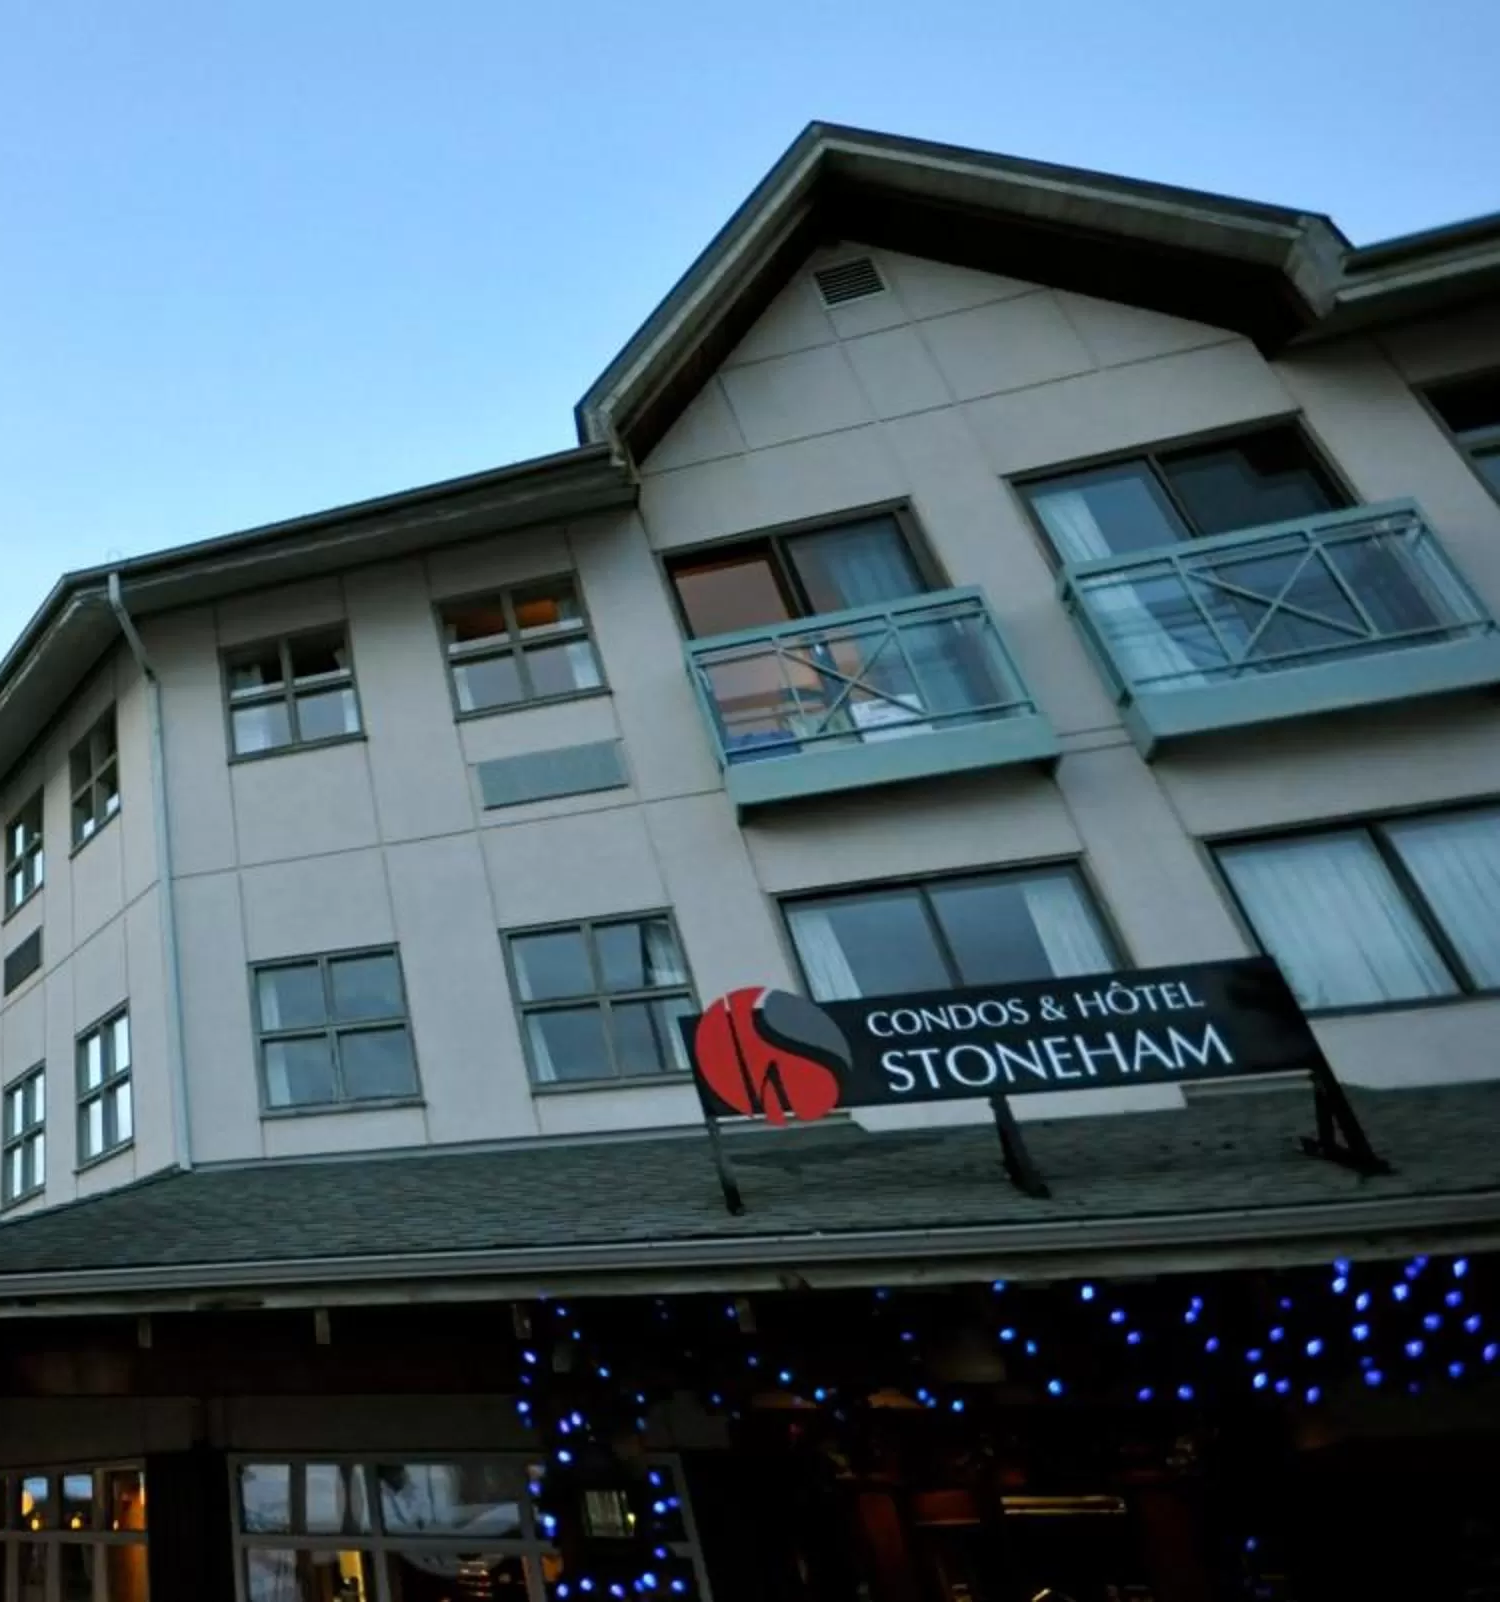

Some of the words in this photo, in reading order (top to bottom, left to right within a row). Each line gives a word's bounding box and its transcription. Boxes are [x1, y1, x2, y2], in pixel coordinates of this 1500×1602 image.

[867, 998, 1029, 1037] CONDOS
[1040, 995, 1067, 1022] &
[1075, 981, 1204, 1017] HÔTEL
[881, 1024, 1233, 1092] STONEHAM
